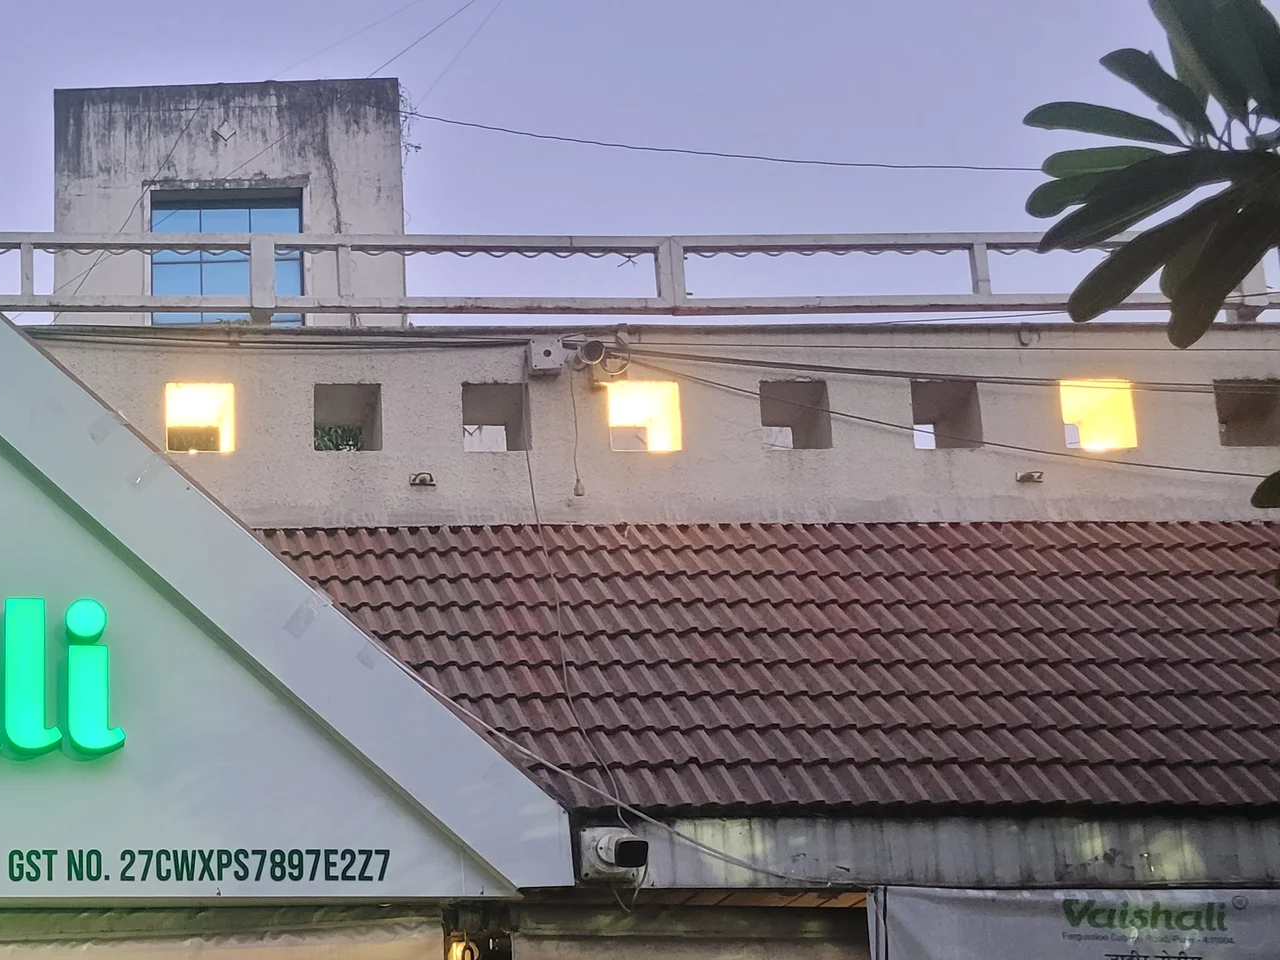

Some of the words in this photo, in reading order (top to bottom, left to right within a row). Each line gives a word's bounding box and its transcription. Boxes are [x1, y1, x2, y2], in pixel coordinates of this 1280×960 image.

[8, 848, 58, 883] GST
[67, 848, 111, 883] NO.
[1061, 898, 1229, 932] Vaishali
